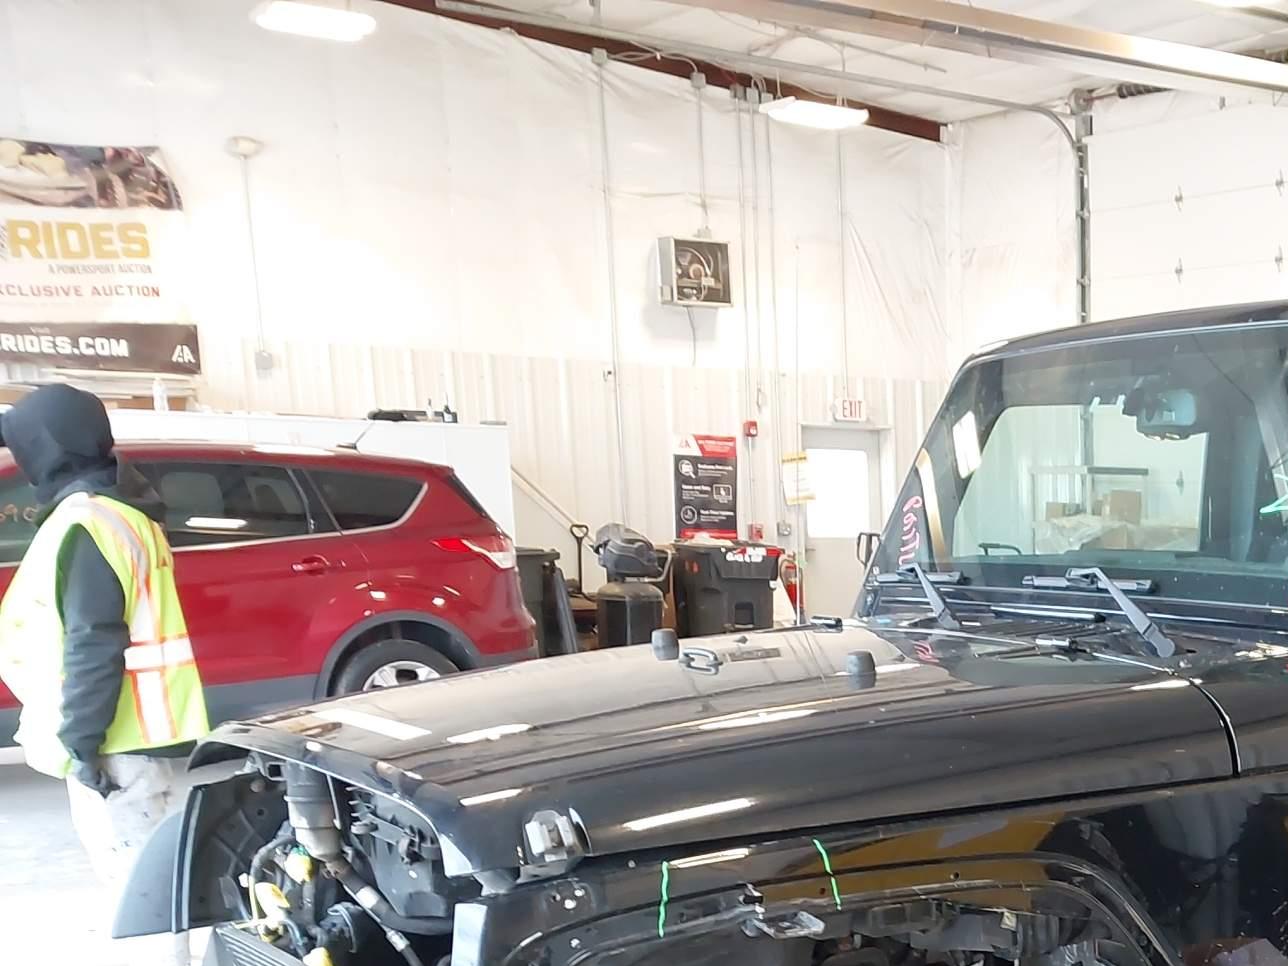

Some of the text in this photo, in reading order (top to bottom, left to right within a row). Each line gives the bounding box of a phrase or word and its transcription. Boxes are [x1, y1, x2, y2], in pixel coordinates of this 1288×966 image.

[6, 219, 150, 259] RIDES
[90, 284, 160, 297] AUCTION
[0, 333, 129, 357] RIDES.COM
[842, 399, 862, 418] EXIT
